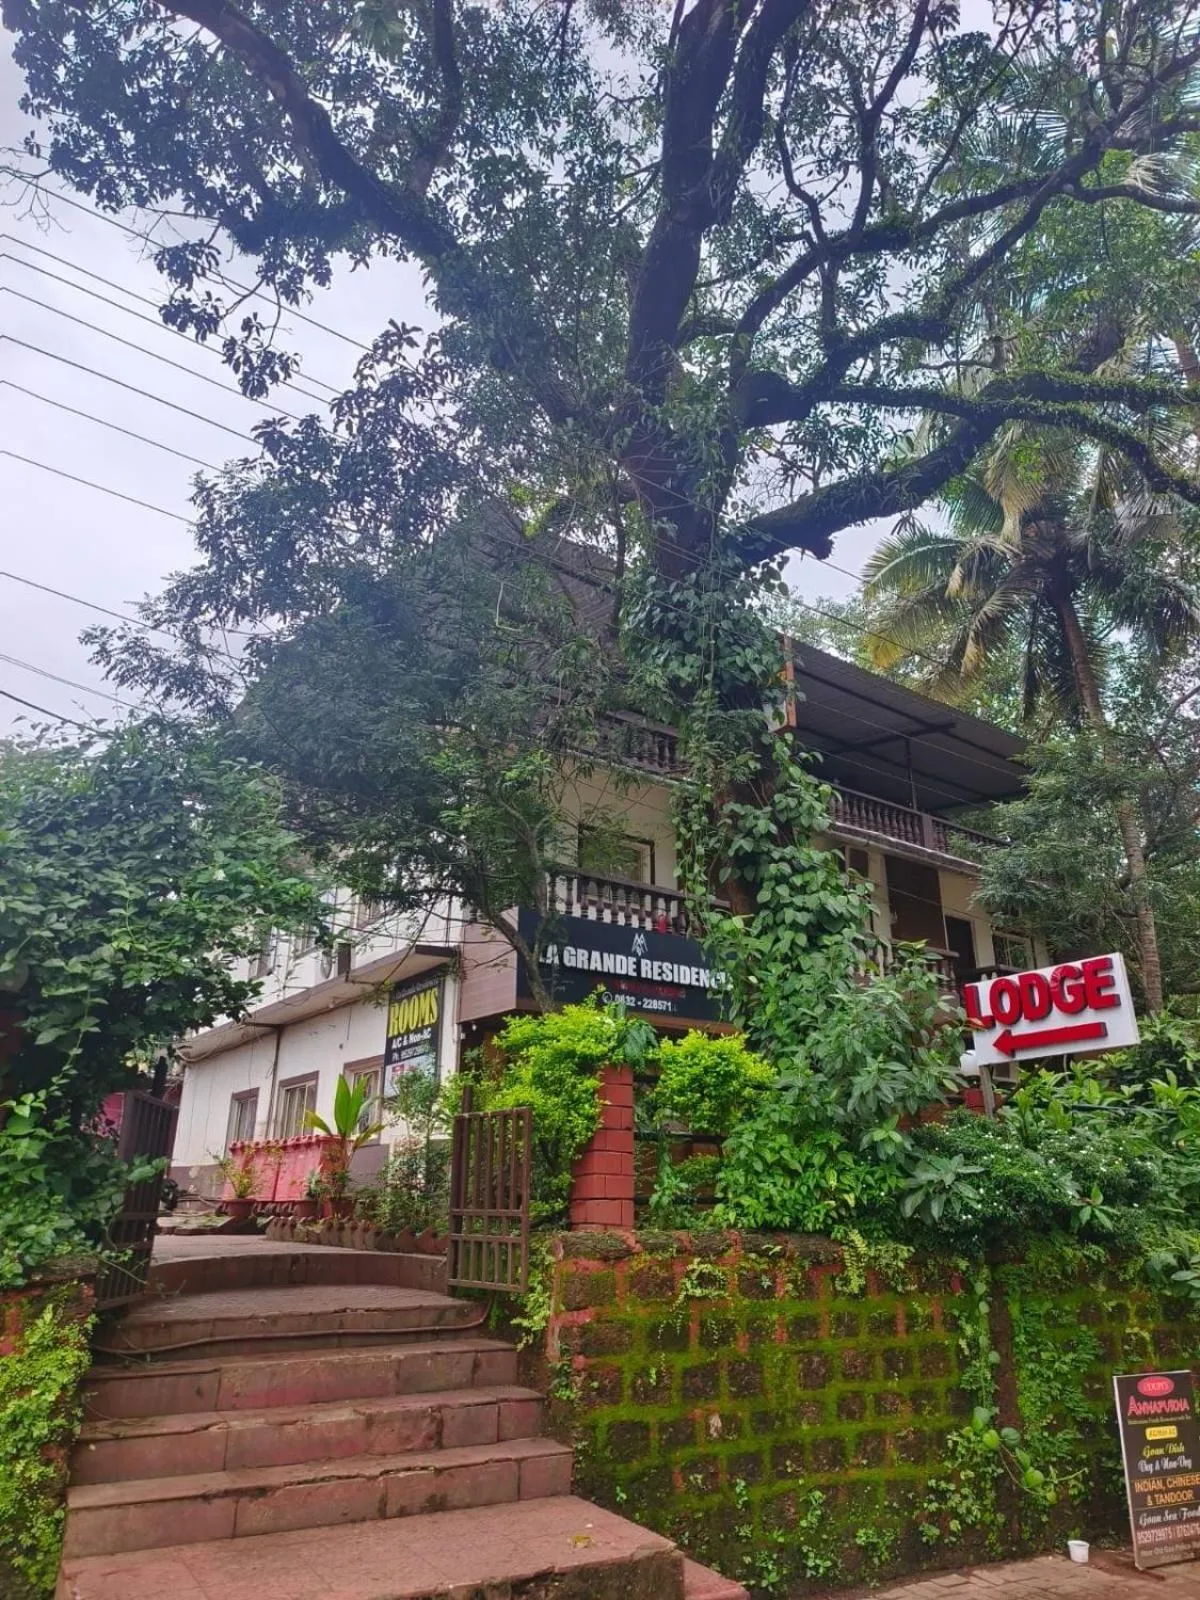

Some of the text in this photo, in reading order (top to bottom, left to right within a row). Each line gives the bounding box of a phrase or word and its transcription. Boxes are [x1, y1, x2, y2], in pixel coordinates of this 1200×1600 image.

[563, 946, 637, 977] GRANDE
[388, 987, 438, 1038] ROOMS
[964, 957, 1121, 1030] LODGE
[1154, 1490, 1195, 1505] TANDOOR
